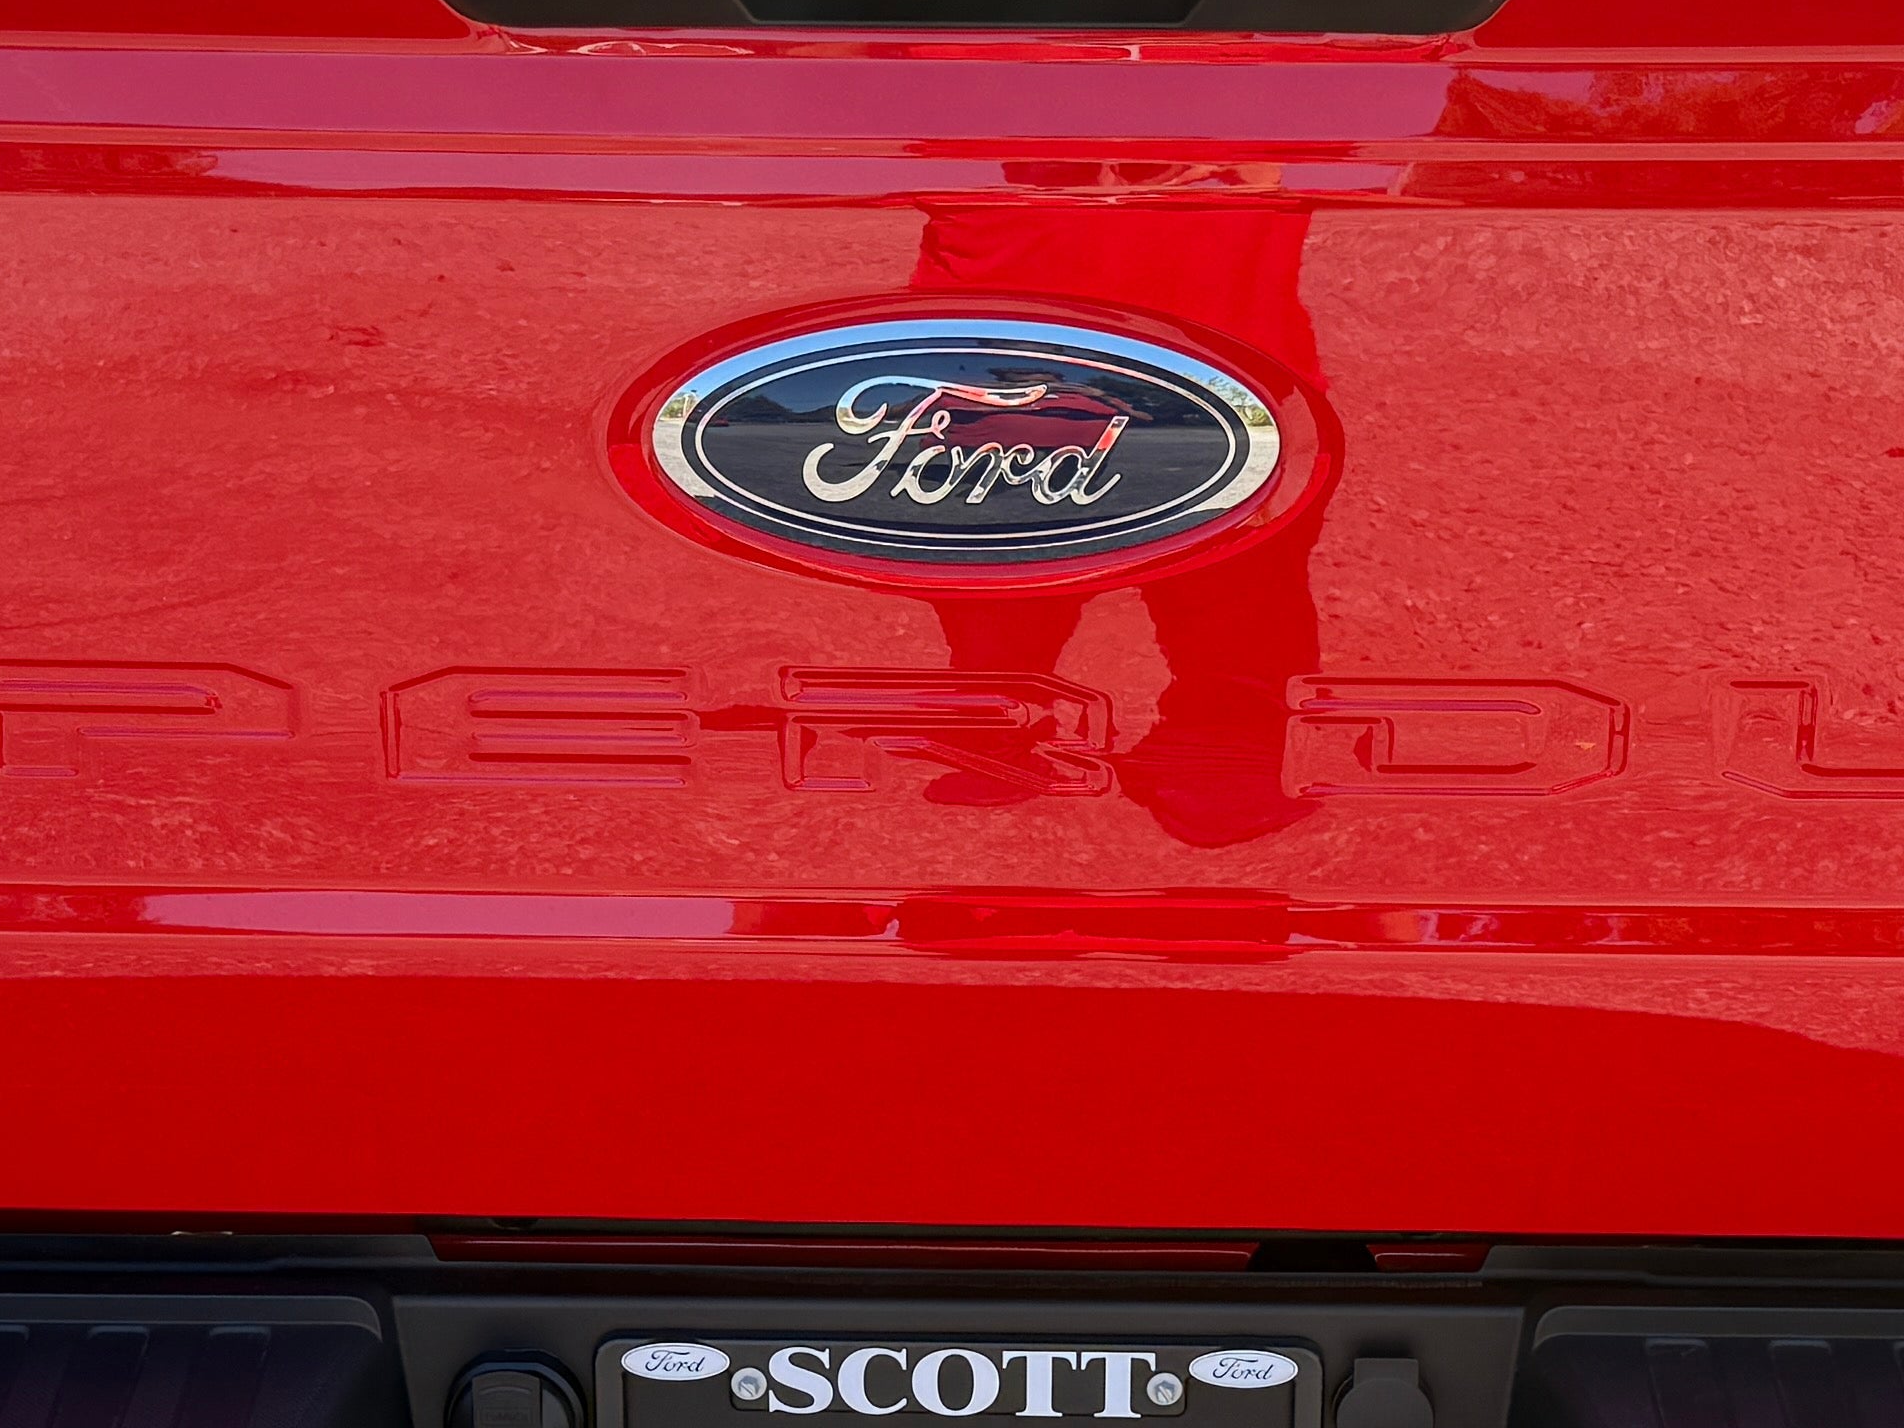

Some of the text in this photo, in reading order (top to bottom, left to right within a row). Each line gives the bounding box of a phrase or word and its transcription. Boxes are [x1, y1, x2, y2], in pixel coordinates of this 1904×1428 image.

[802, 375, 1130, 505] Ford
[645, 1349, 704, 1373] Ford
[768, 1346, 1157, 1419] SCOTT
[1212, 1357, 1272, 1381] Ford
